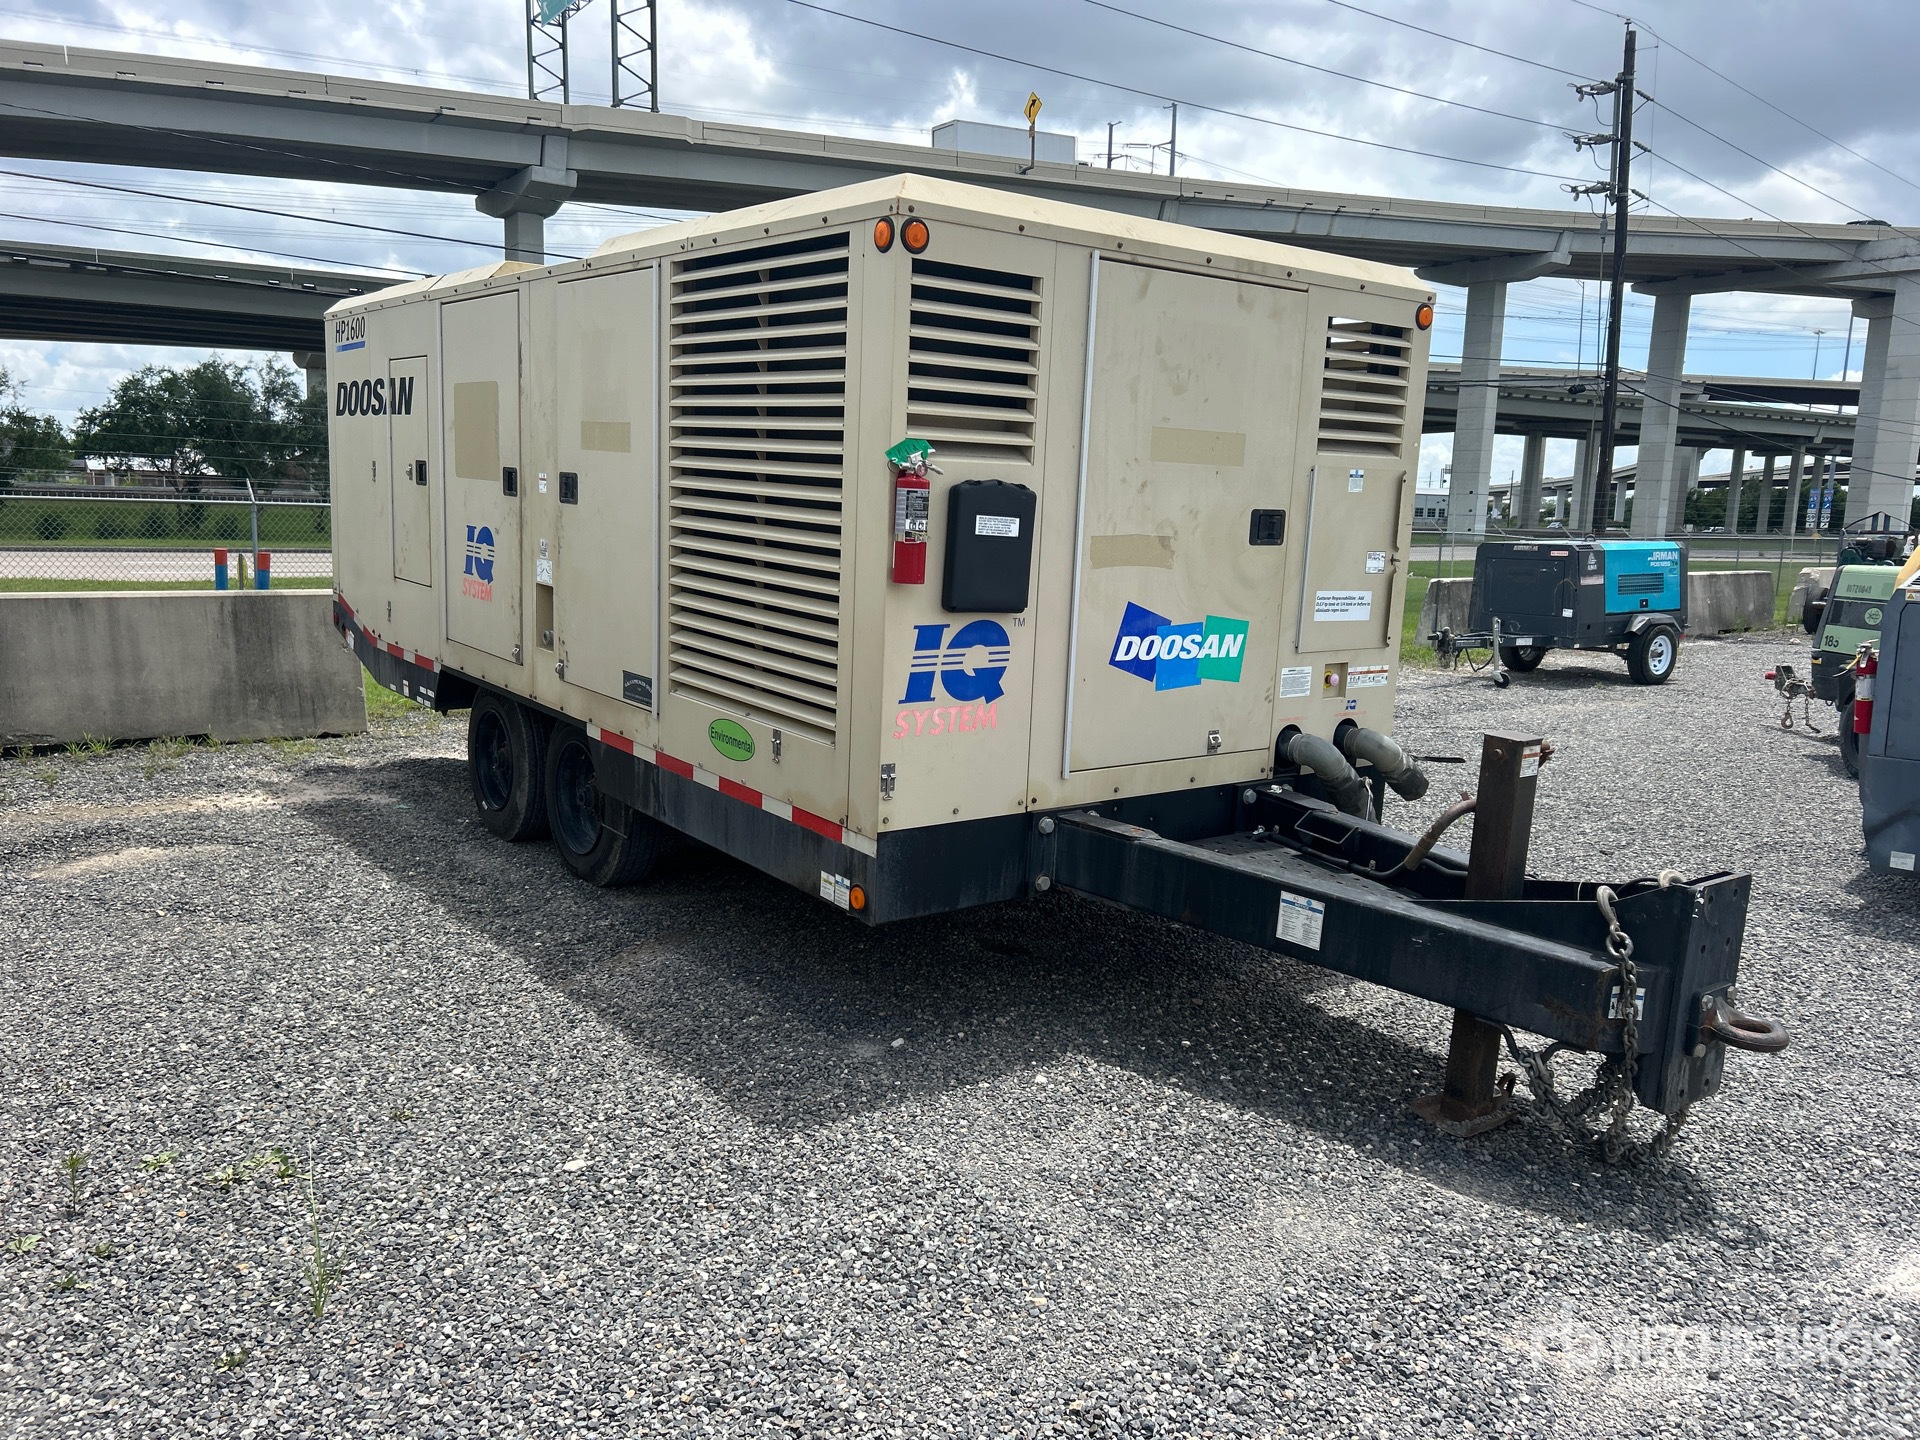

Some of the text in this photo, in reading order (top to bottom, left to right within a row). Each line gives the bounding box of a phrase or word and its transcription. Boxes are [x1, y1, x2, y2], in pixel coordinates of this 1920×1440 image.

[335, 315, 366, 344] HP1600
[335, 376, 414, 417] DOOSAN
[463, 524, 495, 585] IQ
[462, 577, 493, 603] SYSTEM
[1012, 617, 1026, 628] TM
[898, 619, 1011, 704] IQ
[1114, 633, 1245, 662] DOOSAN
[892, 703, 998, 740] SYSTEM
[710, 726, 753, 754] Environmental
